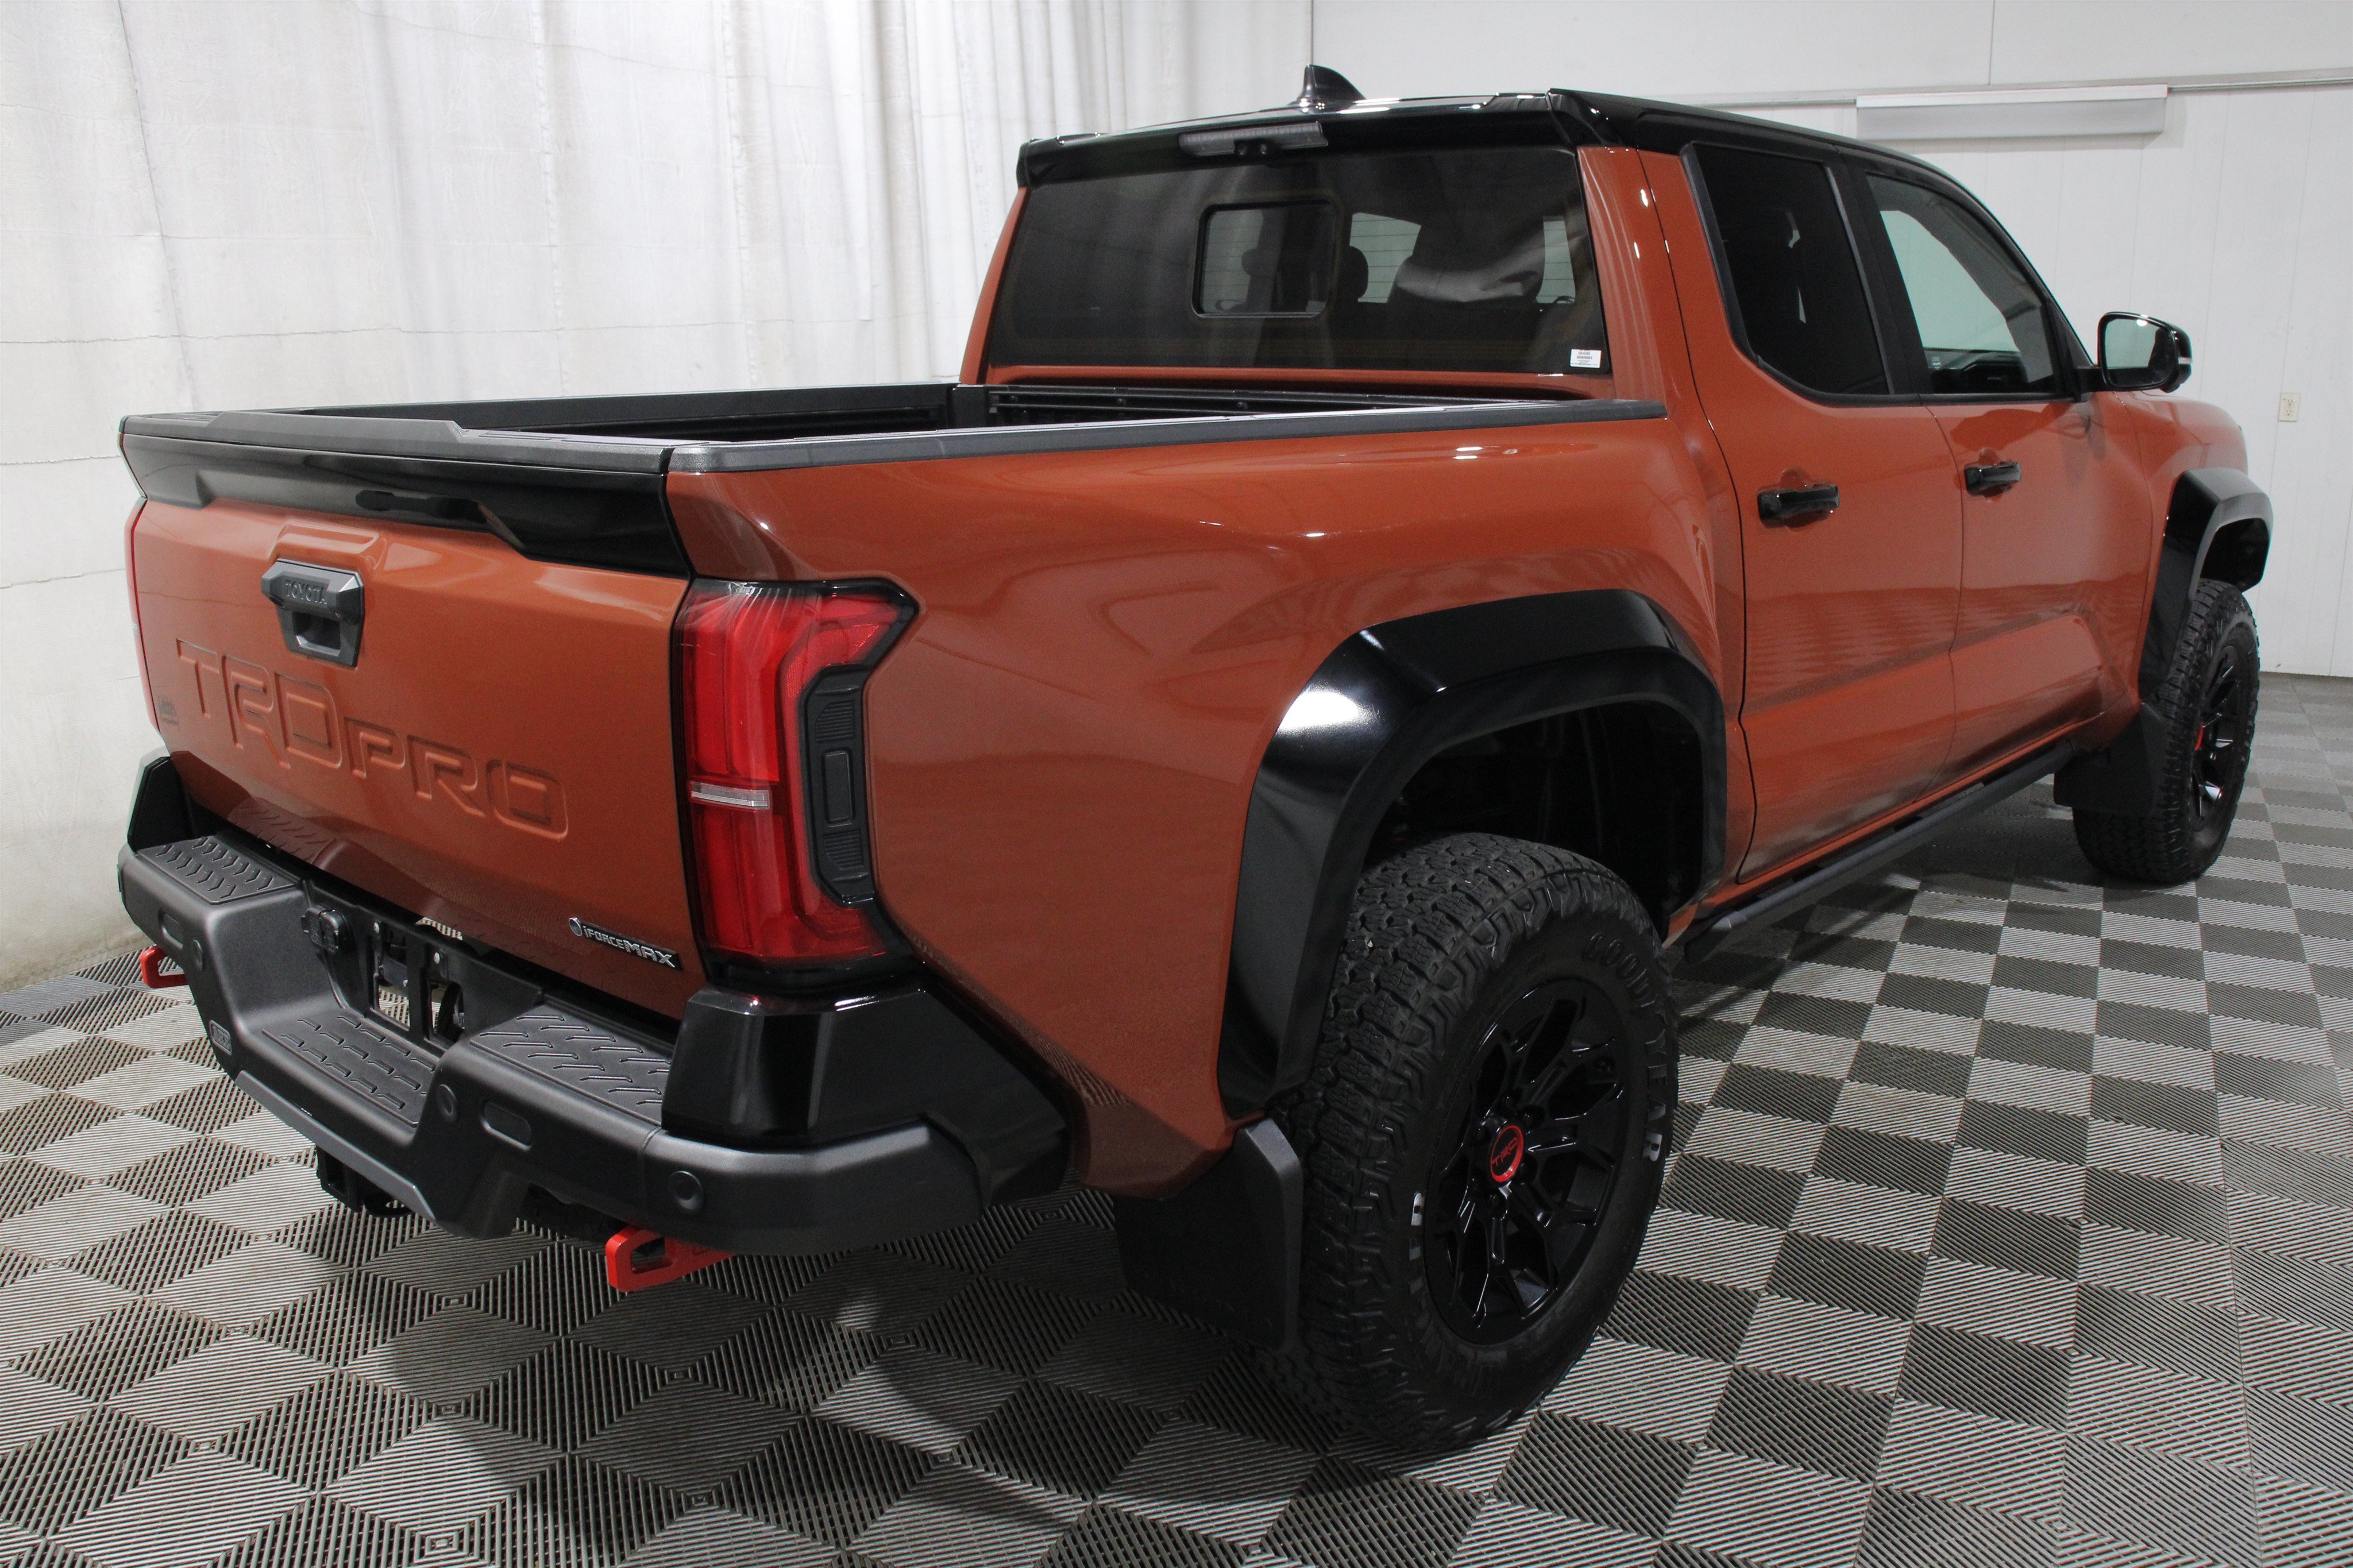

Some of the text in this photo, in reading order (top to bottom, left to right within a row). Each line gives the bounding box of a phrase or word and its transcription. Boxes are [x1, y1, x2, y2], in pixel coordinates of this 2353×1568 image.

[285, 579, 327, 605] TOYOTA
[1583, 932, 1668, 1162] GOODYEAR
[1491, 1137, 1518, 1166] TRD
